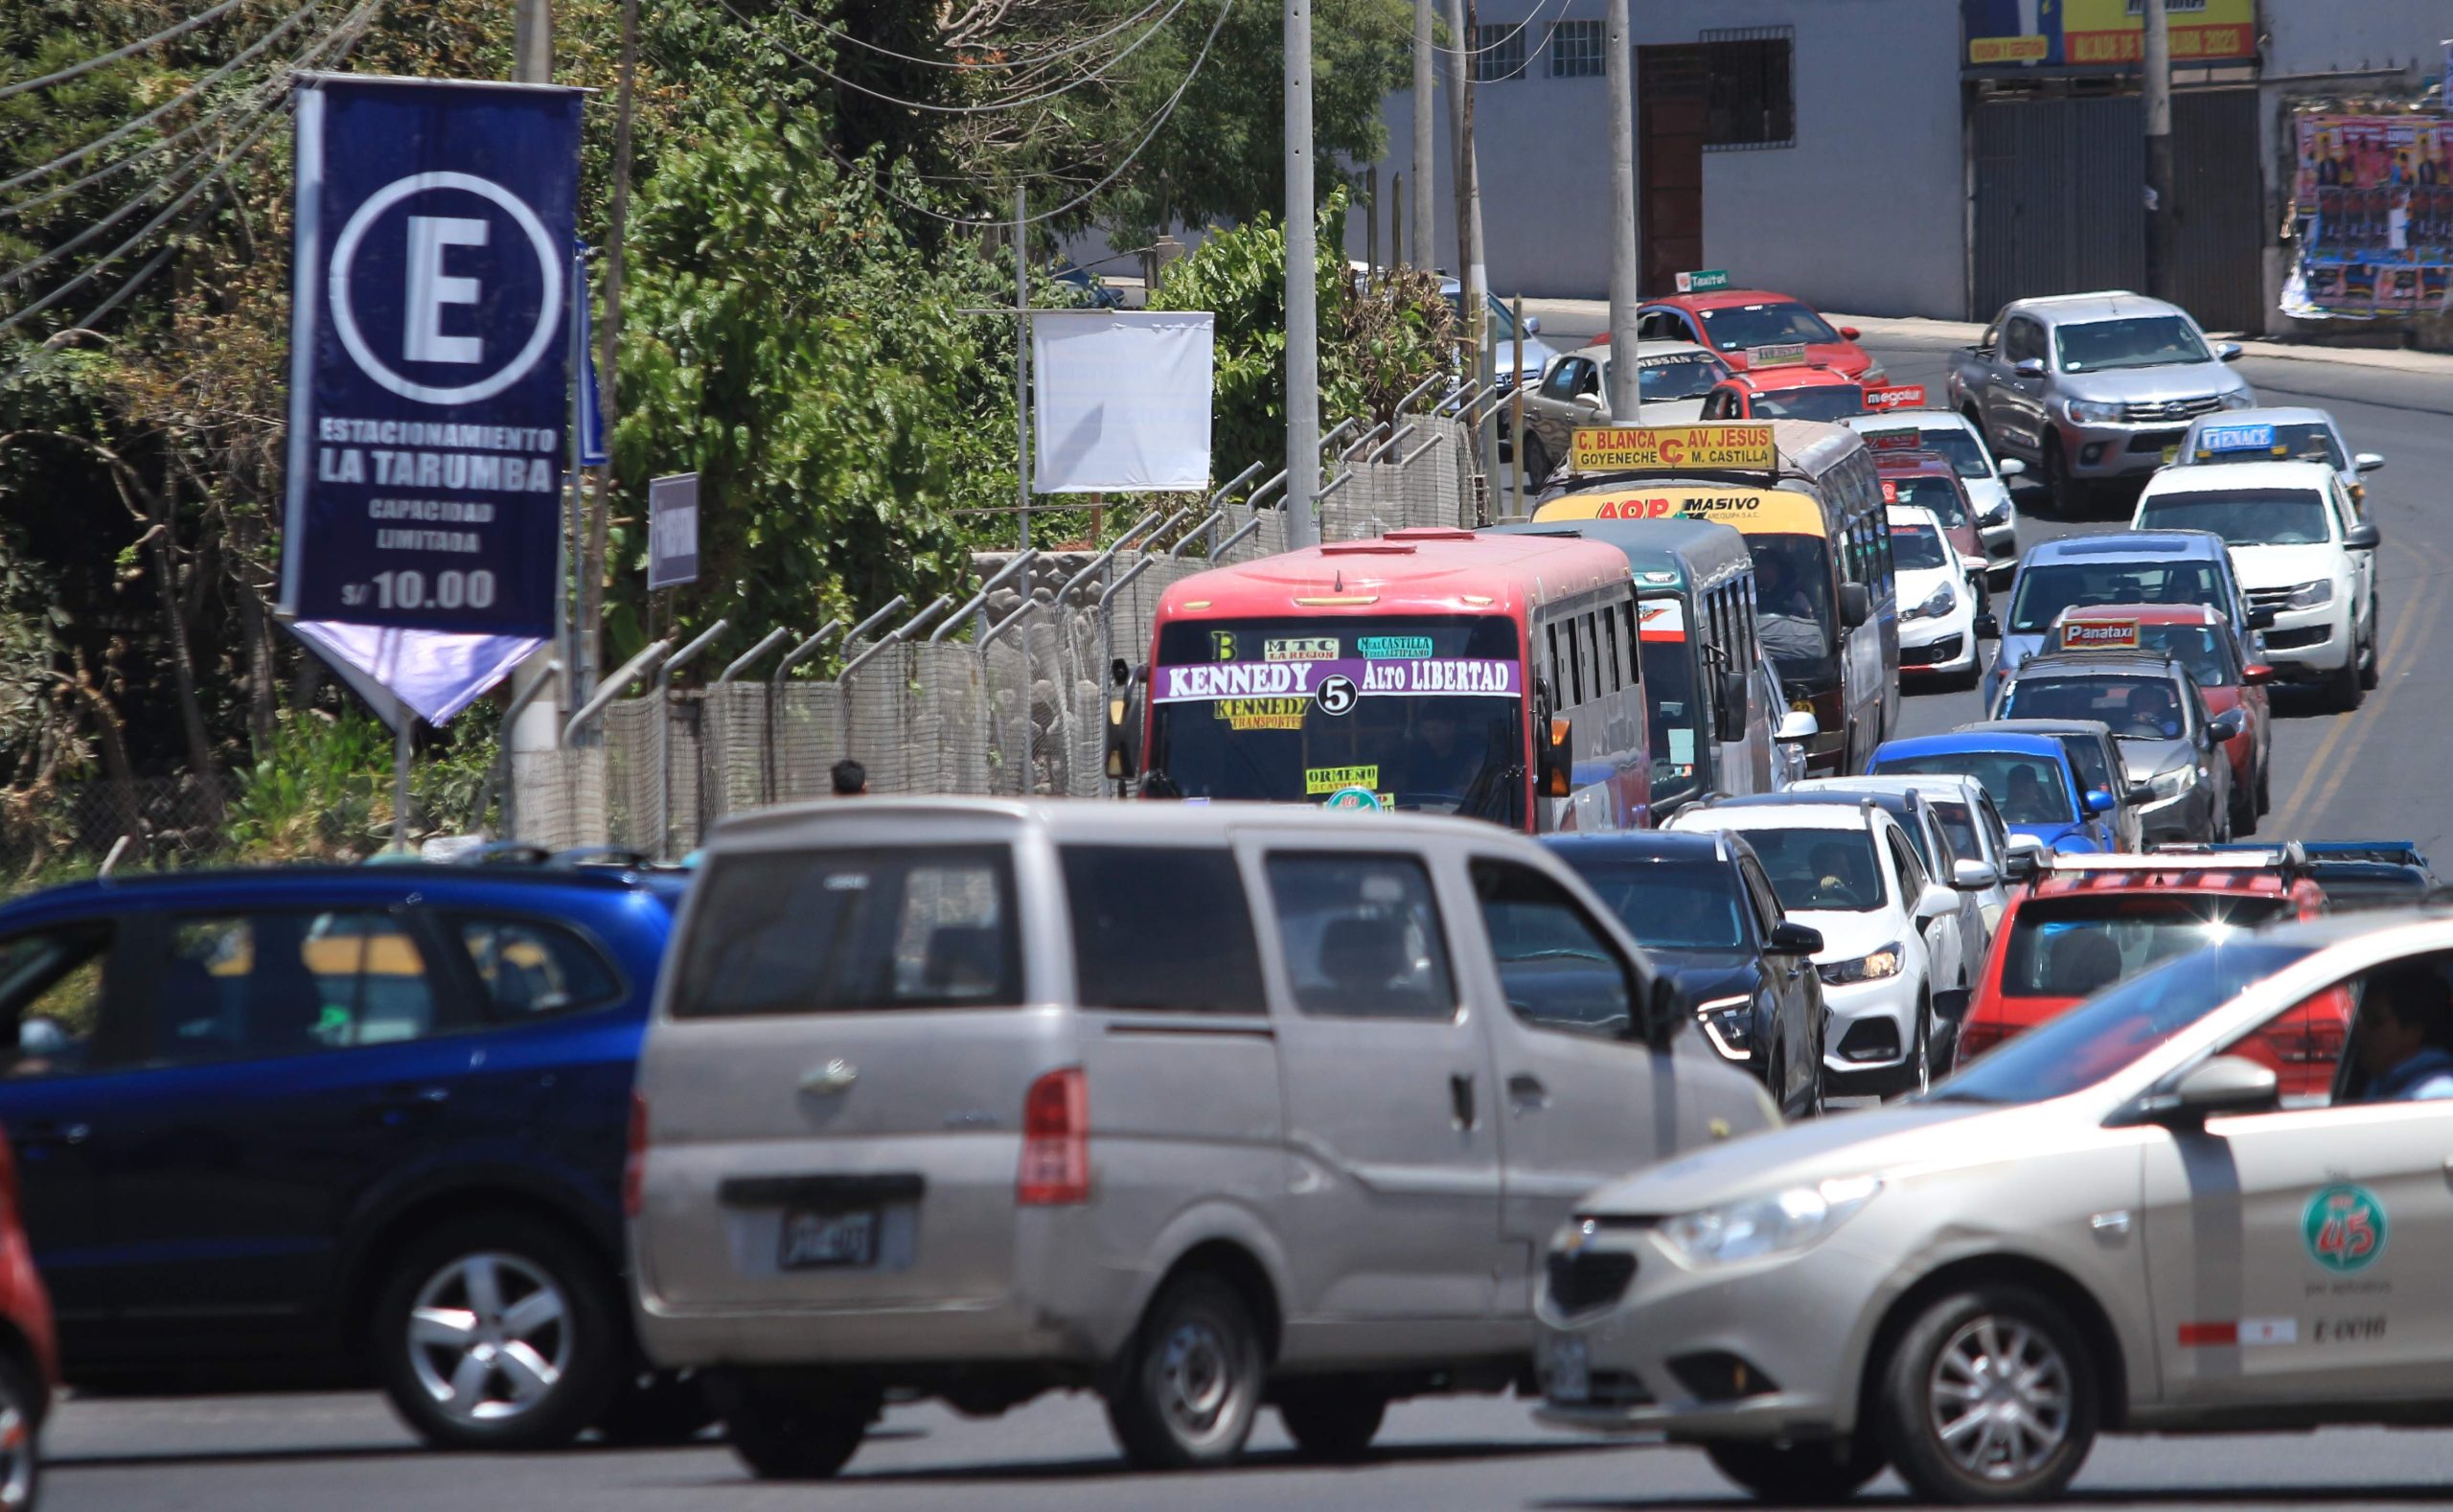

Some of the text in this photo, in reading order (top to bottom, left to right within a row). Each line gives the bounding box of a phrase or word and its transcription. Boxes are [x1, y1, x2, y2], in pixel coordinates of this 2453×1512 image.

[402, 216, 490, 364] E
[1638, 355, 1691, 369] NISSAN
[319, 416, 558, 453] ESTACIONAMIENTO
[1578, 430, 1657, 449] C. BLANCA
[1687, 428, 1769, 447] AV. JESUS
[1581, 451, 1658, 465] GOYENECHE
[1659, 439, 1685, 463] C
[1691, 449, 1768, 464] M. CASTILLA
[319, 447, 554, 493] LA TARUMBA
[368, 497, 496, 523] CAPACIDAD
[1683, 497, 1760, 511] MASIVO
[376, 528, 483, 553] LIMITADA
[372, 569, 497, 609] 10.00
[1381, 637, 1430, 650] CASTILLA
[2067, 625, 2133, 642] Panataxi
[1211, 631, 1238, 663] B
[1290, 652, 1335, 660] REGION
[1168, 662, 1313, 698] KENNEDY
[1410, 660, 1509, 691] LIBERTAD
[1324, 679, 1349, 710] 5
[1215, 698, 1308, 718] KENNEDY
[2317, 1204, 2375, 1263] 45
